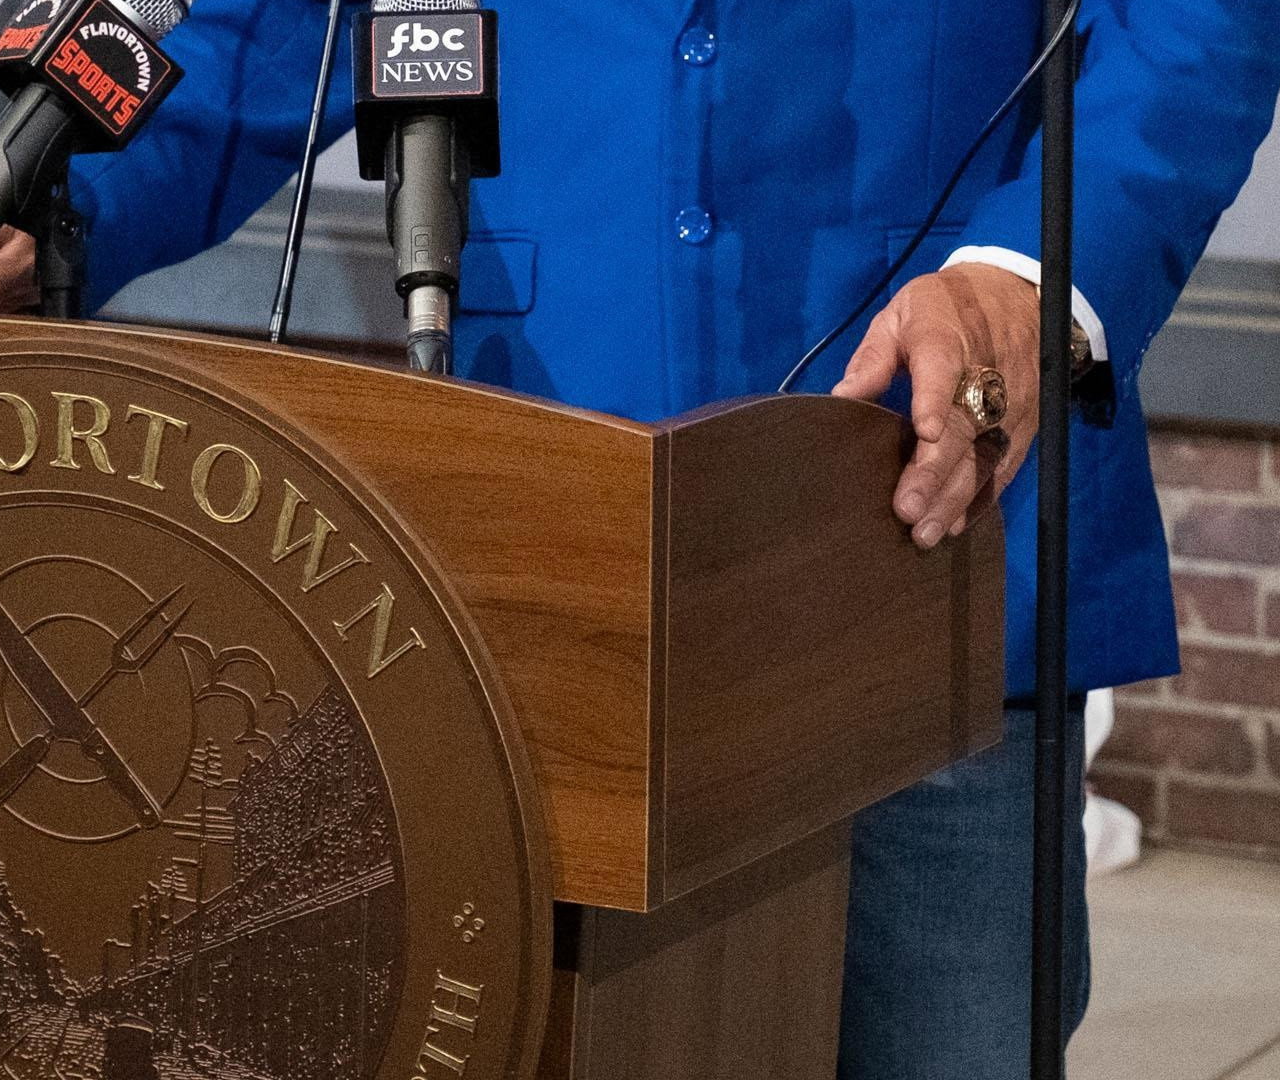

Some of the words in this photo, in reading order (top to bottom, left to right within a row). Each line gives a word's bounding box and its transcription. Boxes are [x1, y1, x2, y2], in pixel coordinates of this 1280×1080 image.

[79, 22, 151, 92] FLAVORTOWN
[387, 22, 465, 58] fbc
[51, 39, 141, 126] SPORTS
[381, 61, 473, 83] NEWS
